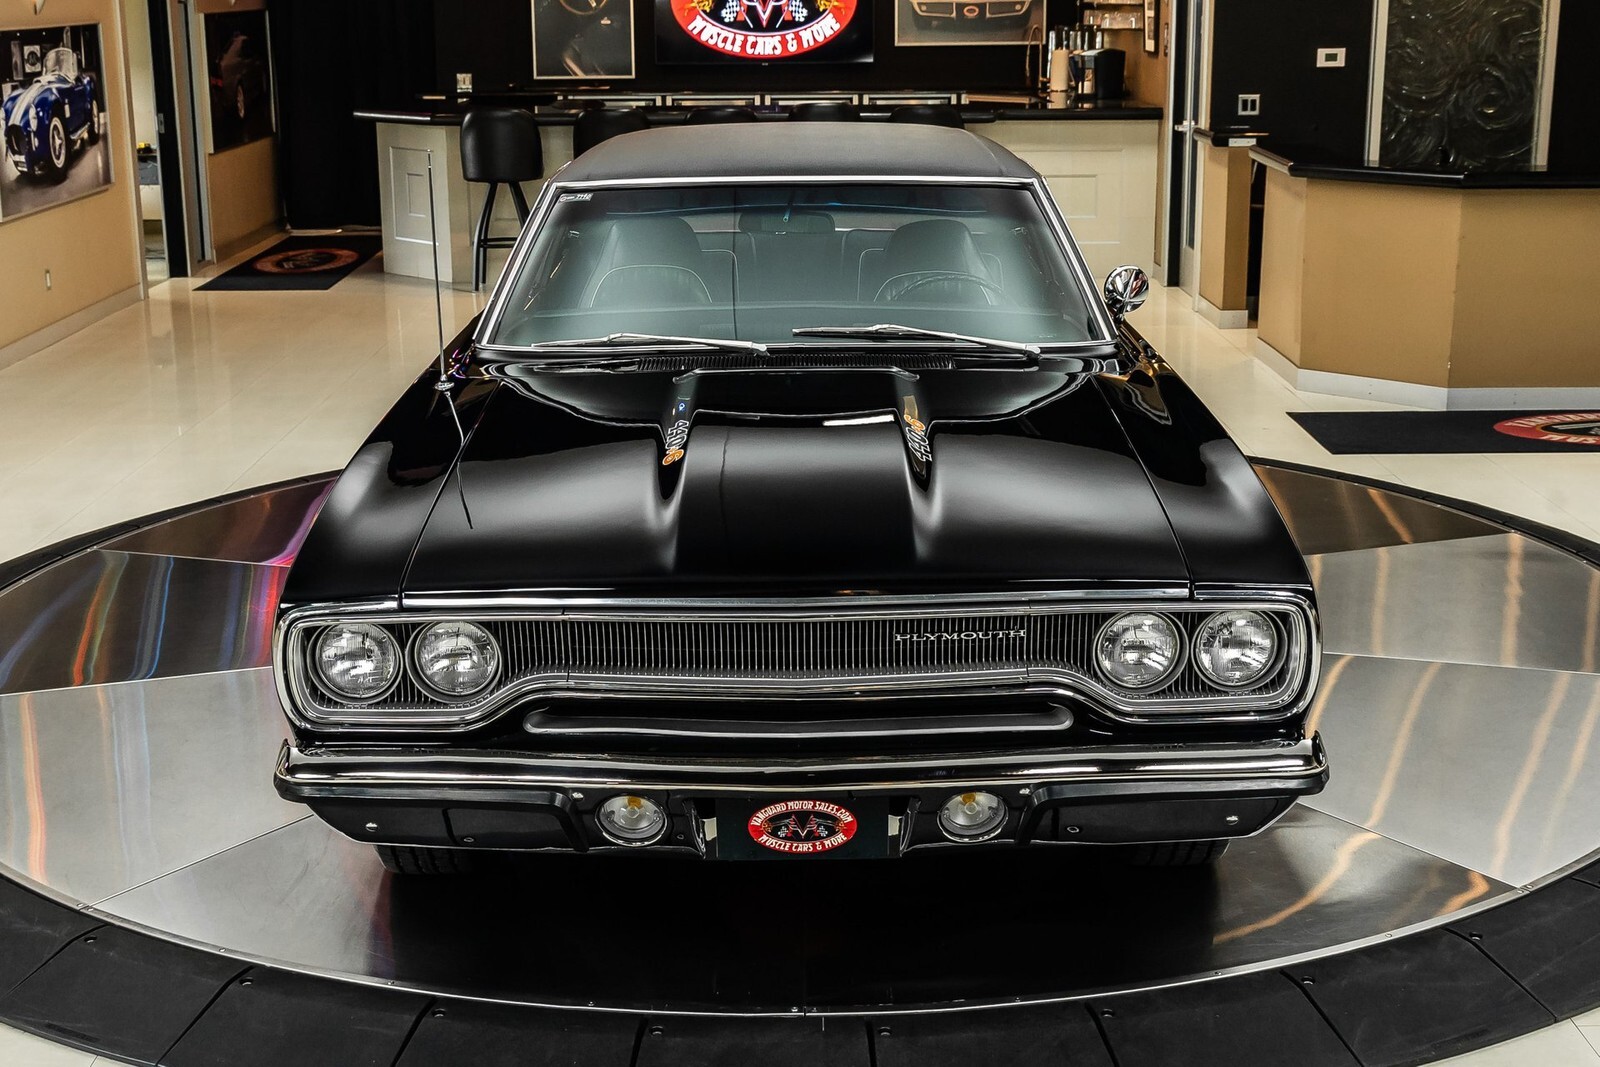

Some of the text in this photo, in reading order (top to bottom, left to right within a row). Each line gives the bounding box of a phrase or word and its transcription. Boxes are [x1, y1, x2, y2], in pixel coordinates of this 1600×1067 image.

[687, 14, 841, 56] MUSCLE CARS & MORE
[895, 628, 1026, 641] PLYMOUTH
[750, 801, 854, 825] VANGUARD MOTOR SALES.COM
[758, 833, 848, 852] MUSCLE CARS & MORE
